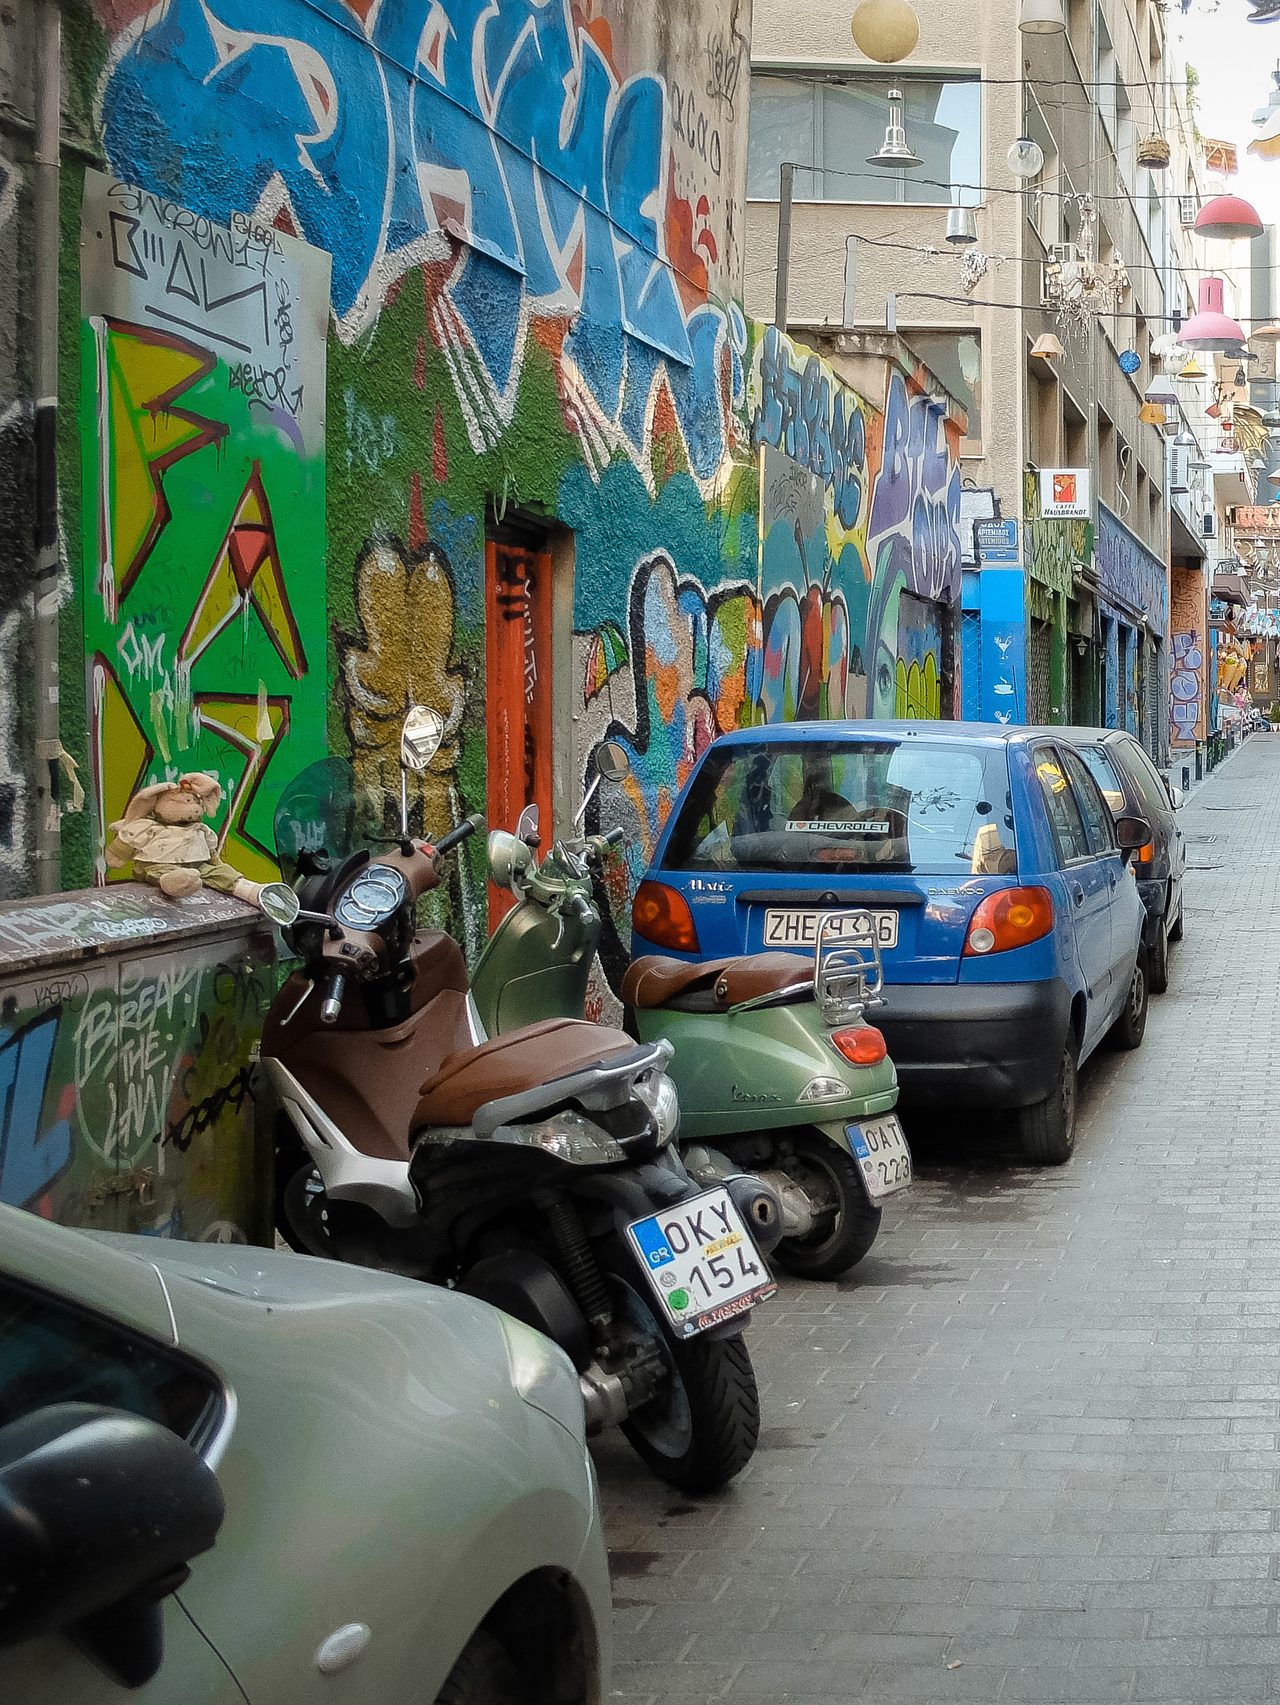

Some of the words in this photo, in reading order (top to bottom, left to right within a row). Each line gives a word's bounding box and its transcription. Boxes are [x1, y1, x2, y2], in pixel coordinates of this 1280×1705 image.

[808, 822, 887, 831] CHEVROLET
[928, 887, 985, 896] DAEWOO
[865, 1122, 901, 1152] OAT
[856, 1145, 869, 1155] GR
[878, 1155, 910, 1185] 223
[664, 1200, 734, 1254] OKY
[649, 1246, 672, 1263] GR
[688, 1246, 759, 1298] 154
